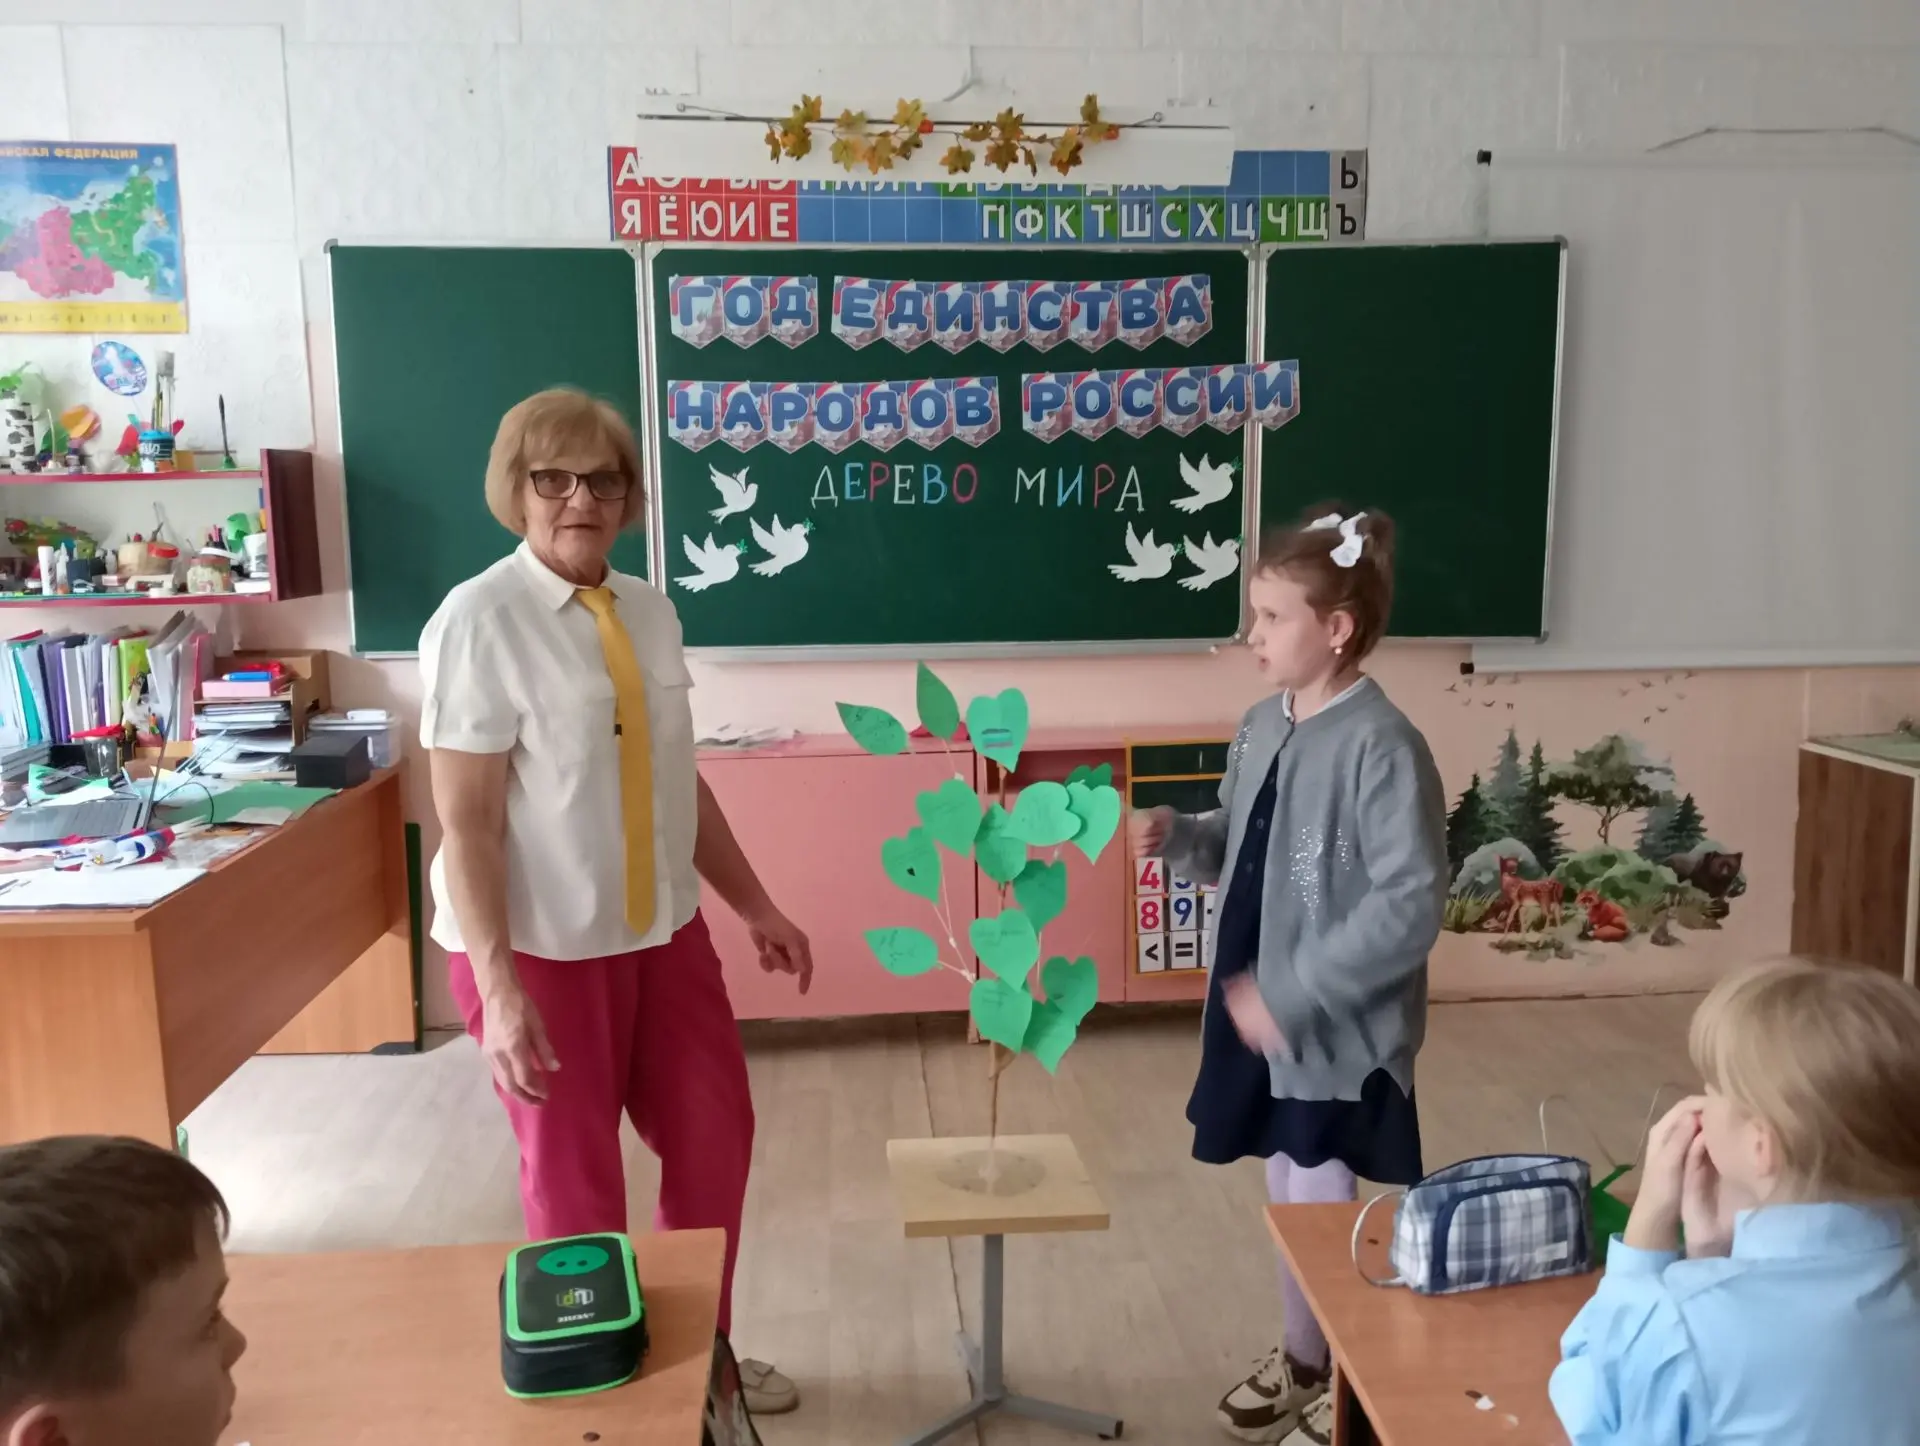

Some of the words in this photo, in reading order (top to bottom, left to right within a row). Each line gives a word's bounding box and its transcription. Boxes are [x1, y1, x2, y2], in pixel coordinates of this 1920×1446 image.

[54, 147, 138, 160] ФЕДЕРАЦИЯ
[677, 284, 812, 327] ГОД
[839, 286, 1207, 332] ЕДИНСТВА
[675, 388, 992, 432] НАРОДОВ
[1029, 369, 1294, 422] РОССИИ
[811, 462, 978, 508] ДЕРЕВО
[1015, 463, 1144, 512] МИРА
[1139, 861, 1160, 889] 4
[1141, 901, 1159, 930] 8
[1174, 898, 1192, 926] 9
